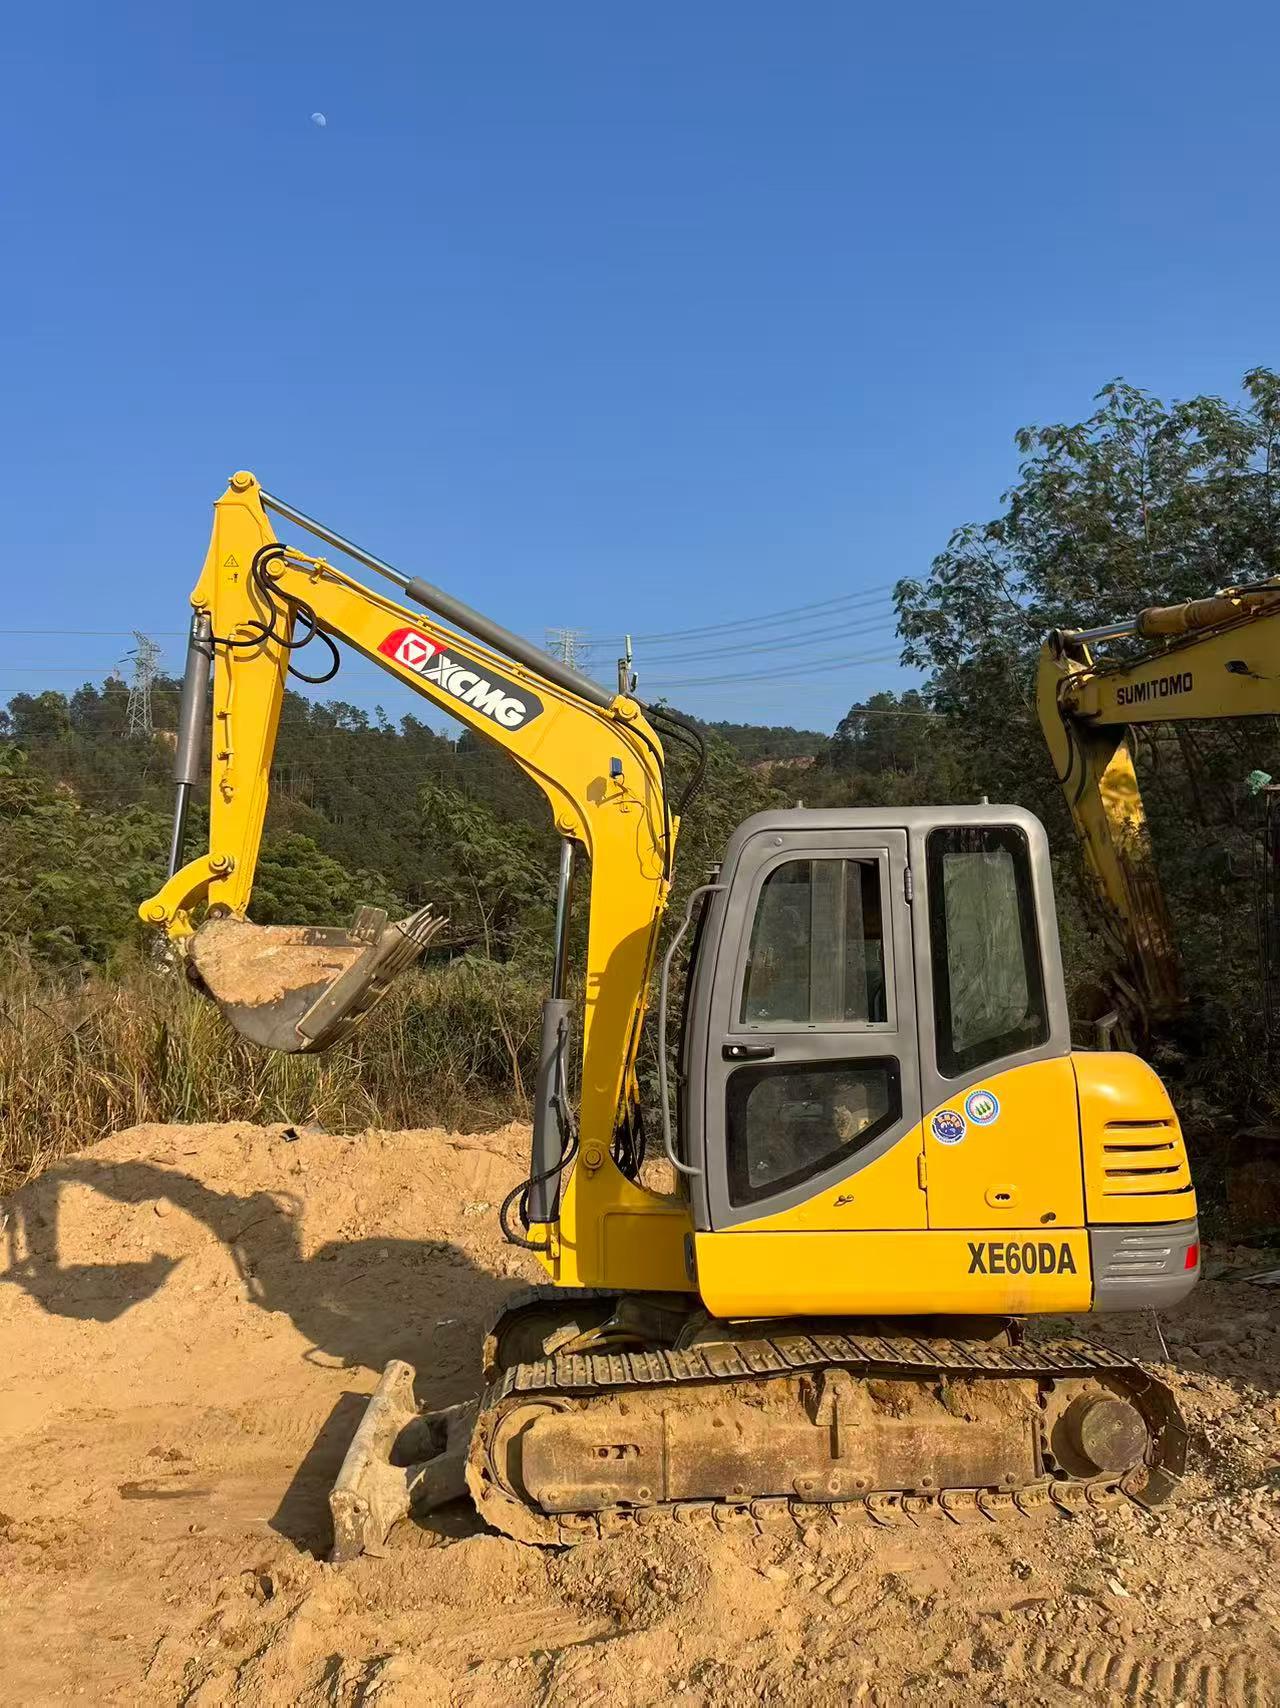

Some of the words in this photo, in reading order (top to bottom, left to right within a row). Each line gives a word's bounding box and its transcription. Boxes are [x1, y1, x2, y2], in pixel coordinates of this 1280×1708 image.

[421, 653, 527, 727] XCMG
[1117, 672, 1193, 705] SUMITOMO
[967, 1242, 1077, 1274] XE60DA
